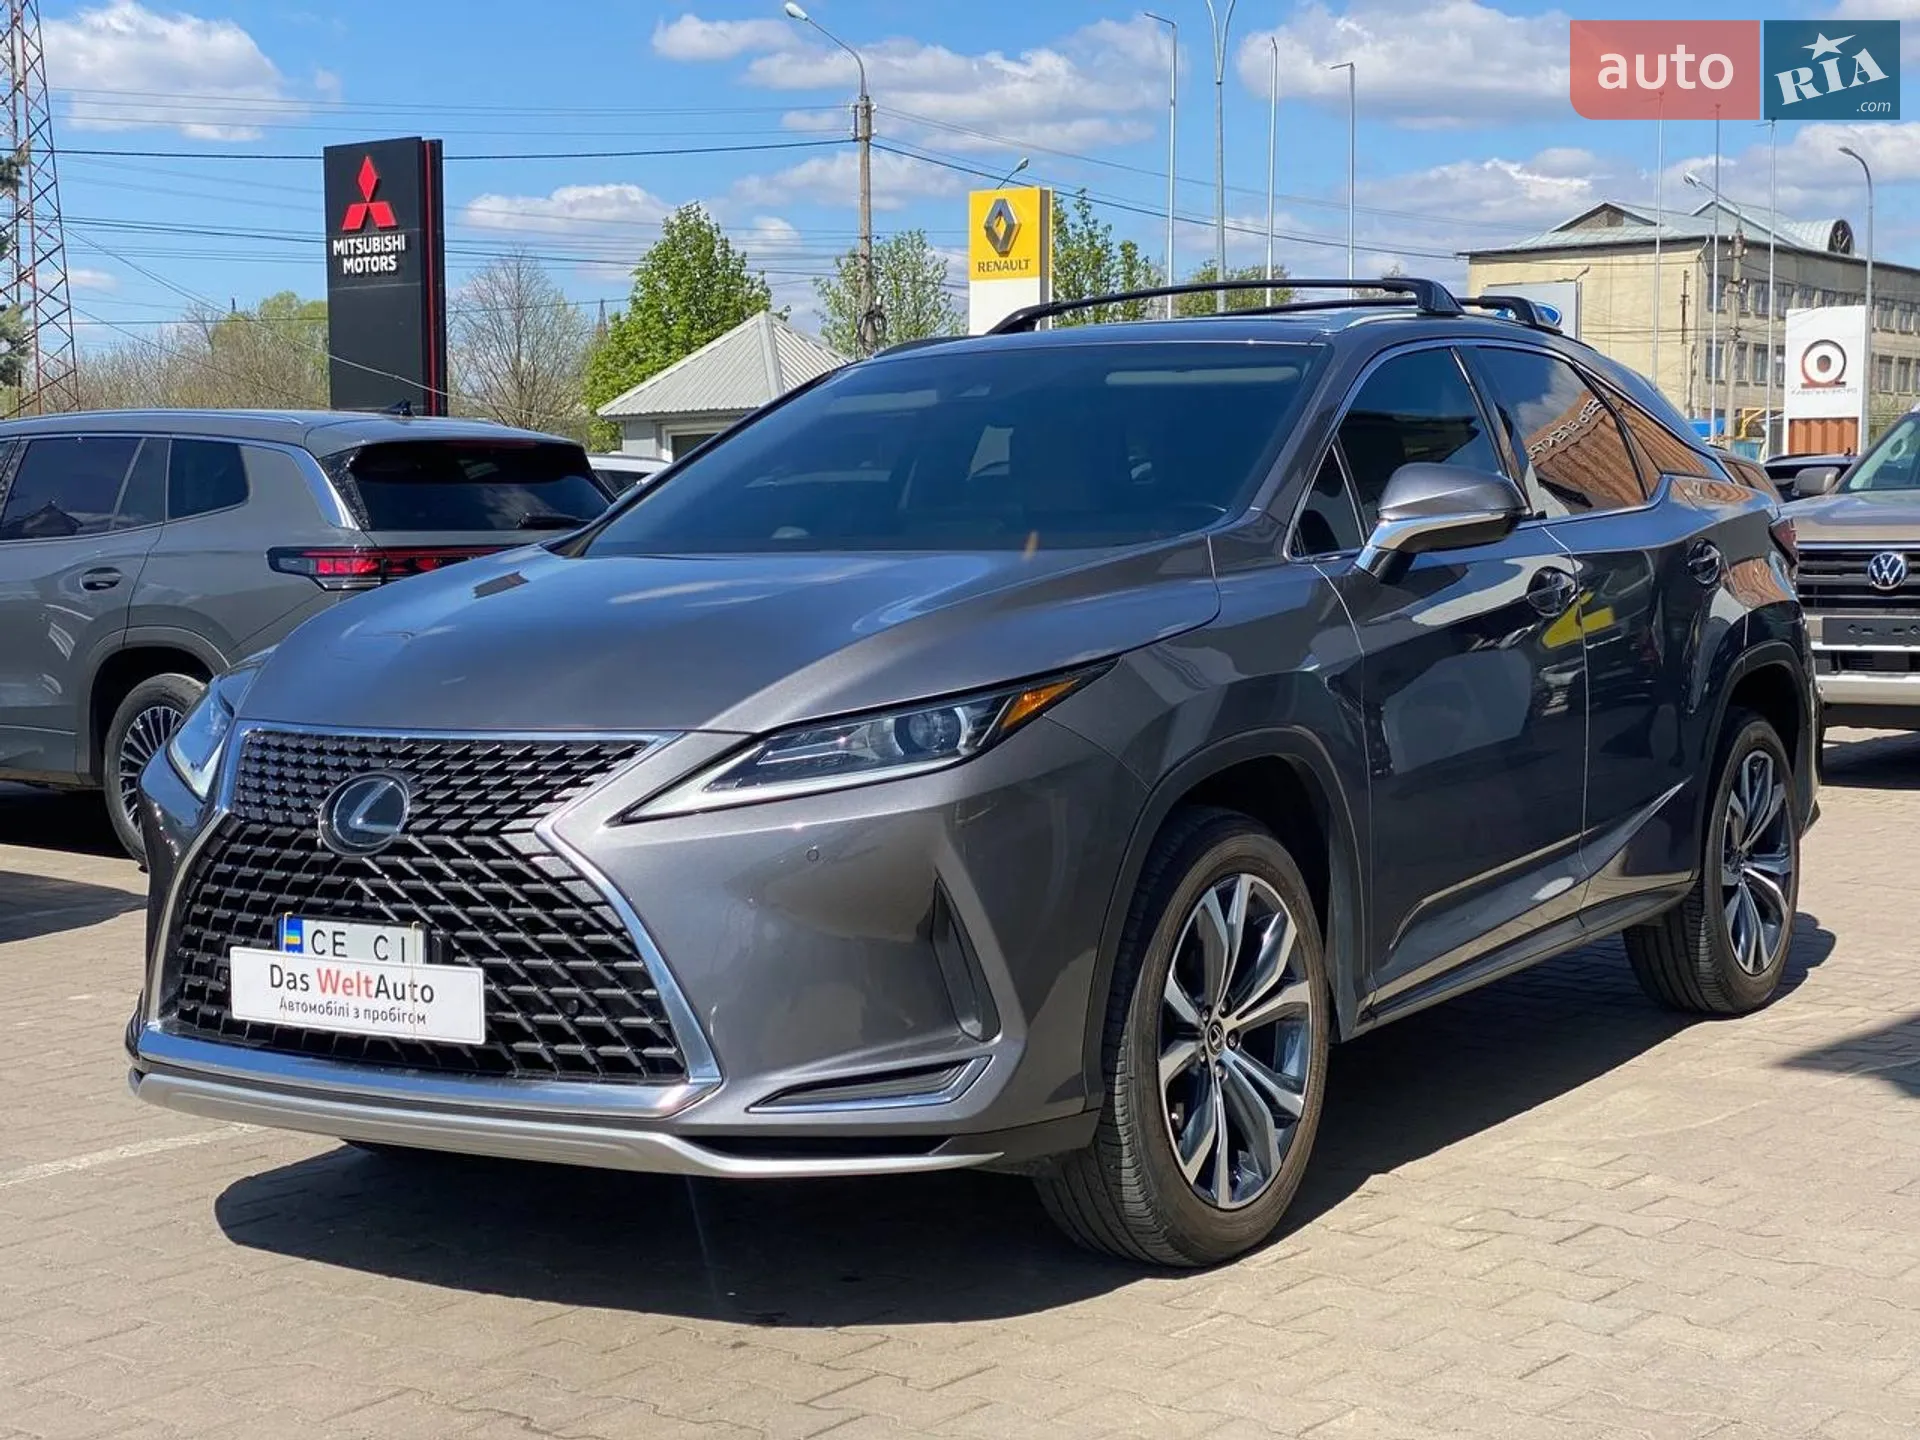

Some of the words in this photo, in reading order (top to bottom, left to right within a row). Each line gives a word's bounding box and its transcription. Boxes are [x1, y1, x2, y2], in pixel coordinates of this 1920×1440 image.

[333, 234, 405, 256] MITSUBISHI
[343, 254, 397, 275] MOTORS
[977, 258, 1031, 273] RENAULT
[311, 929, 348, 958] CE
[269, 964, 310, 992] Das
[316, 967, 434, 1003] WeltAuto
[279, 996, 350, 1018] Автомобілі
[353, 1004, 360, 1018] з
[363, 1004, 426, 1025] пробігом
